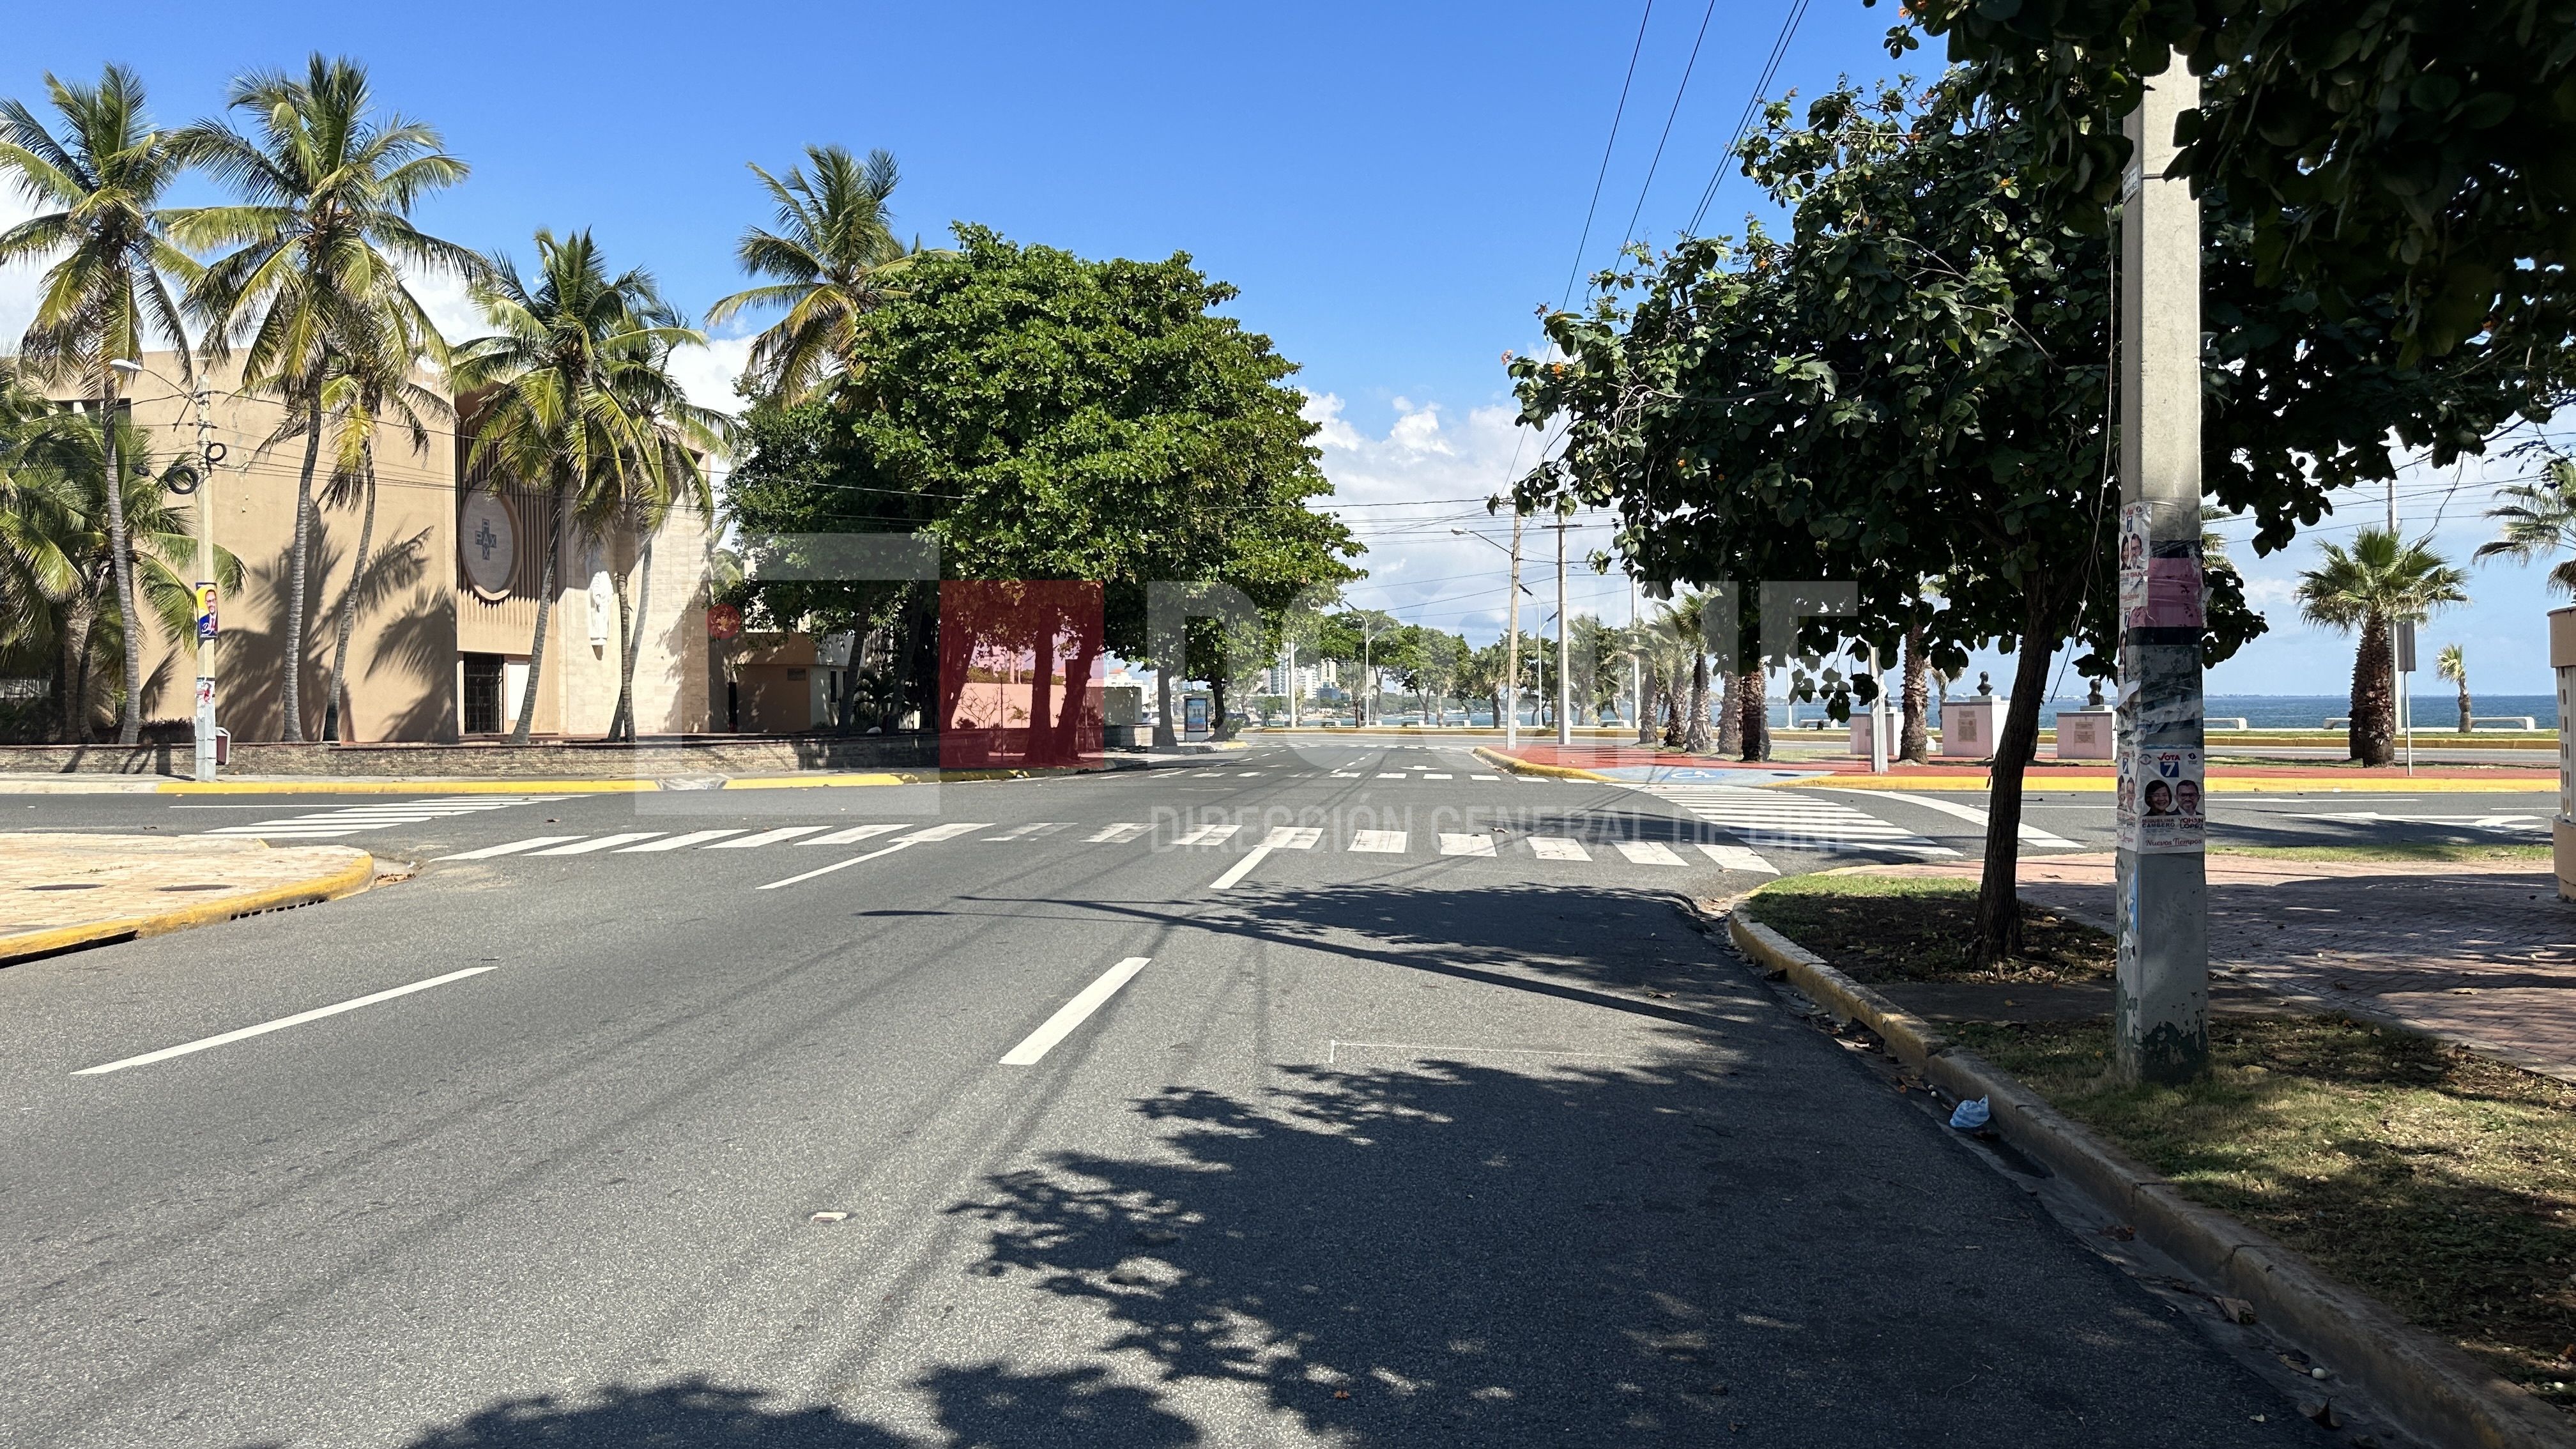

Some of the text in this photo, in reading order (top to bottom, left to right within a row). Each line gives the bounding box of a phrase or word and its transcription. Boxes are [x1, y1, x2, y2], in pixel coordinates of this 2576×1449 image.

[2157, 752, 2181, 761] VOTA
[2164, 762, 2175, 777] 7
[2172, 838, 2202, 847] Tiempos
